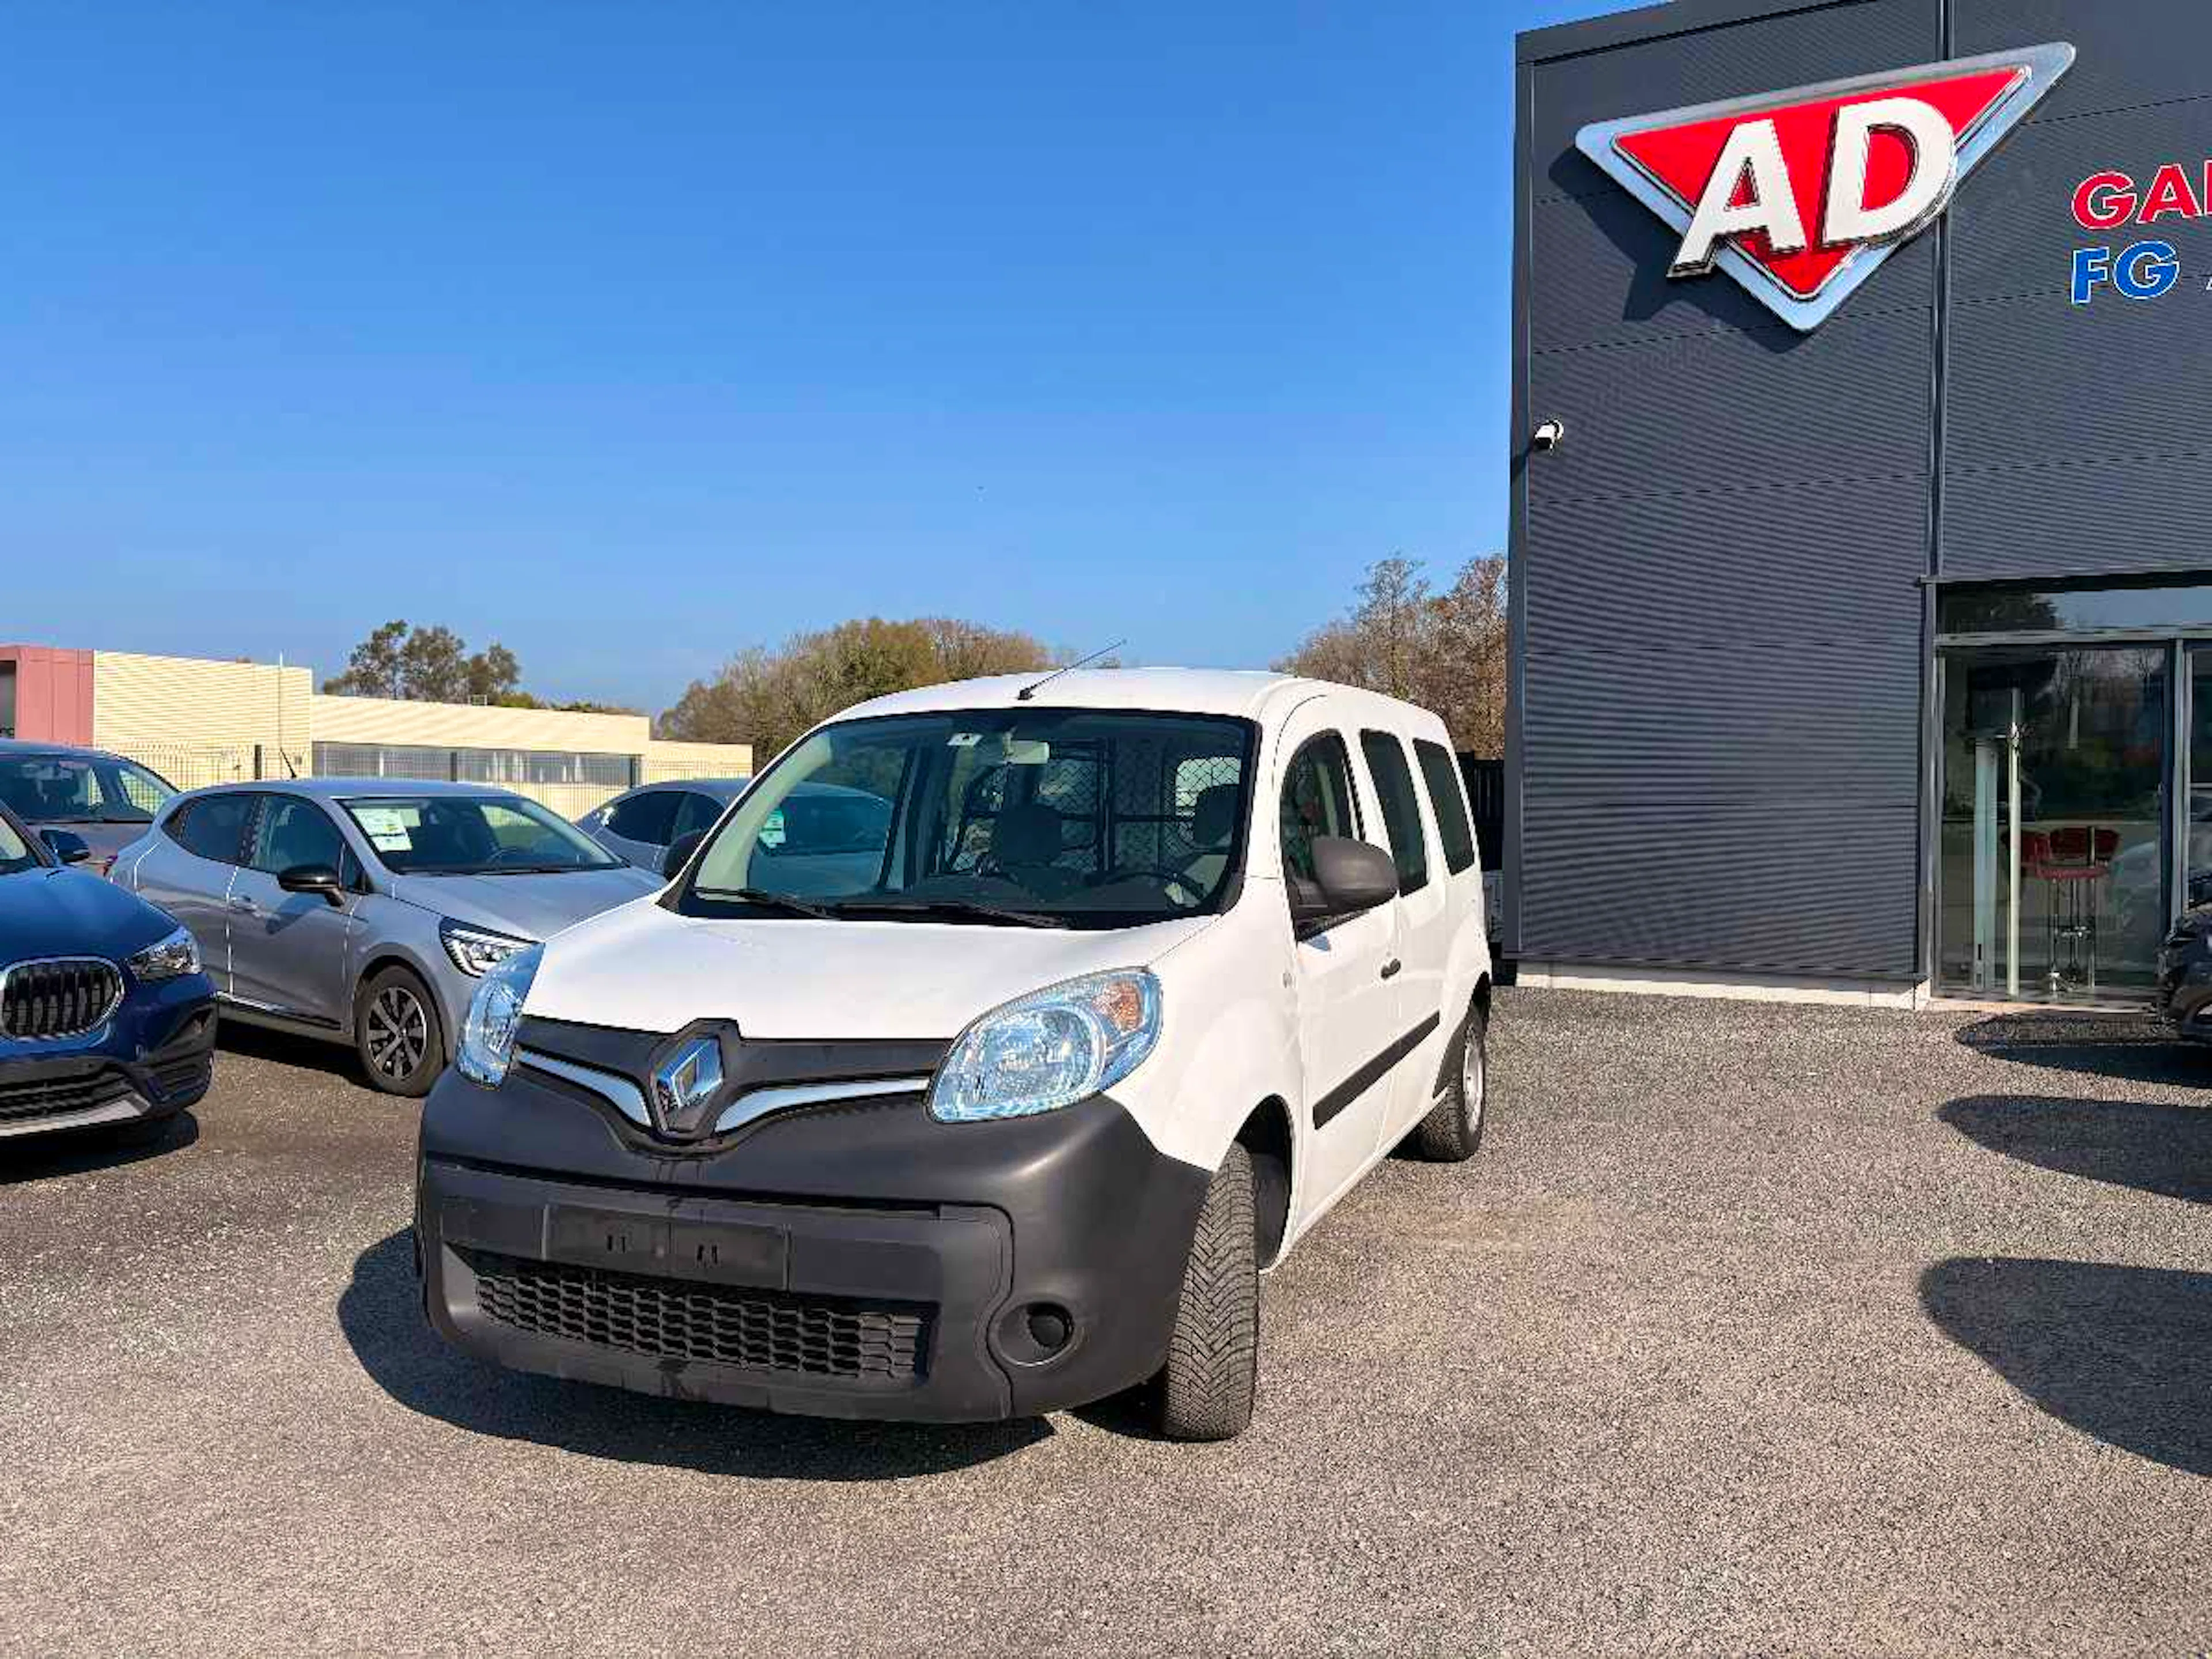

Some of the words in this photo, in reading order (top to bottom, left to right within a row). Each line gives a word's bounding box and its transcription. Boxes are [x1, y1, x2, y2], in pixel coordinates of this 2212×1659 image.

[1666, 97, 1958, 277] AD
[2071, 160, 2212, 229] GA
[2071, 240, 2180, 304] FG
